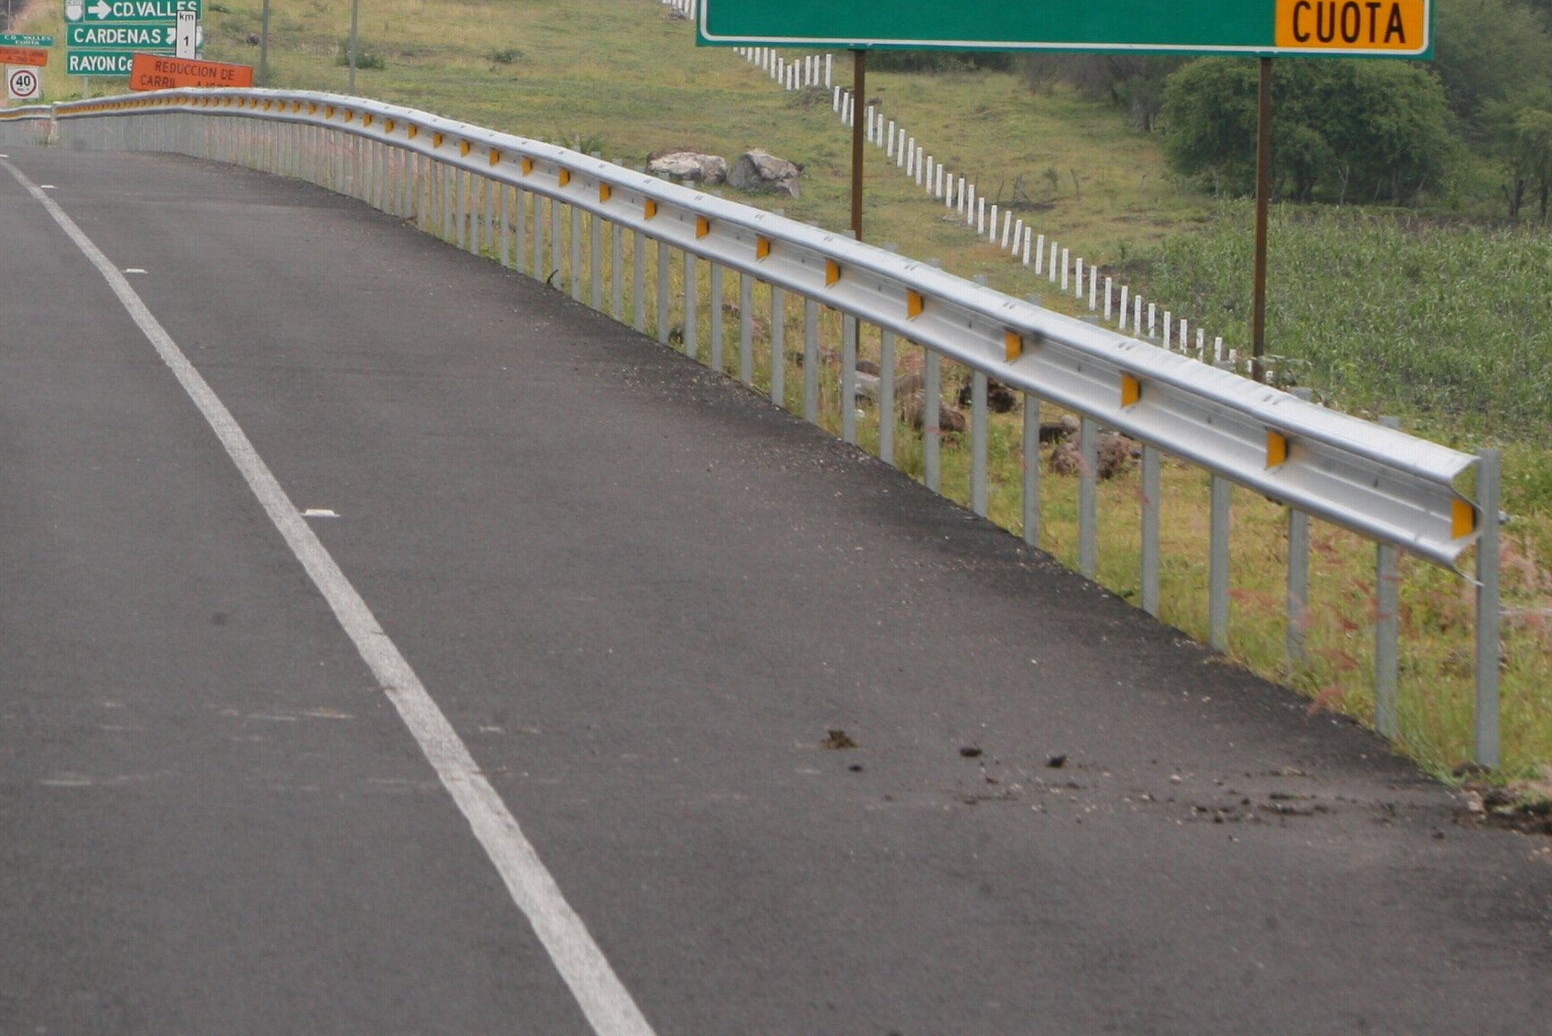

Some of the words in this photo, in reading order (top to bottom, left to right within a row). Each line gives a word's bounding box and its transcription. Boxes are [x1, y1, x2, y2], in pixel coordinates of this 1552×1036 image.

[179, 12, 194, 22] km
[1292, 0, 1406, 44] CUOTA
[73, 28, 162, 44] CARDENAS
[183, 35, 189, 46] 1
[69, 55, 116, 71] RAYON
[154, 60, 217, 78] REDUCCION
[220, 69, 235, 81] DE
[15, 75, 31, 87] 40
